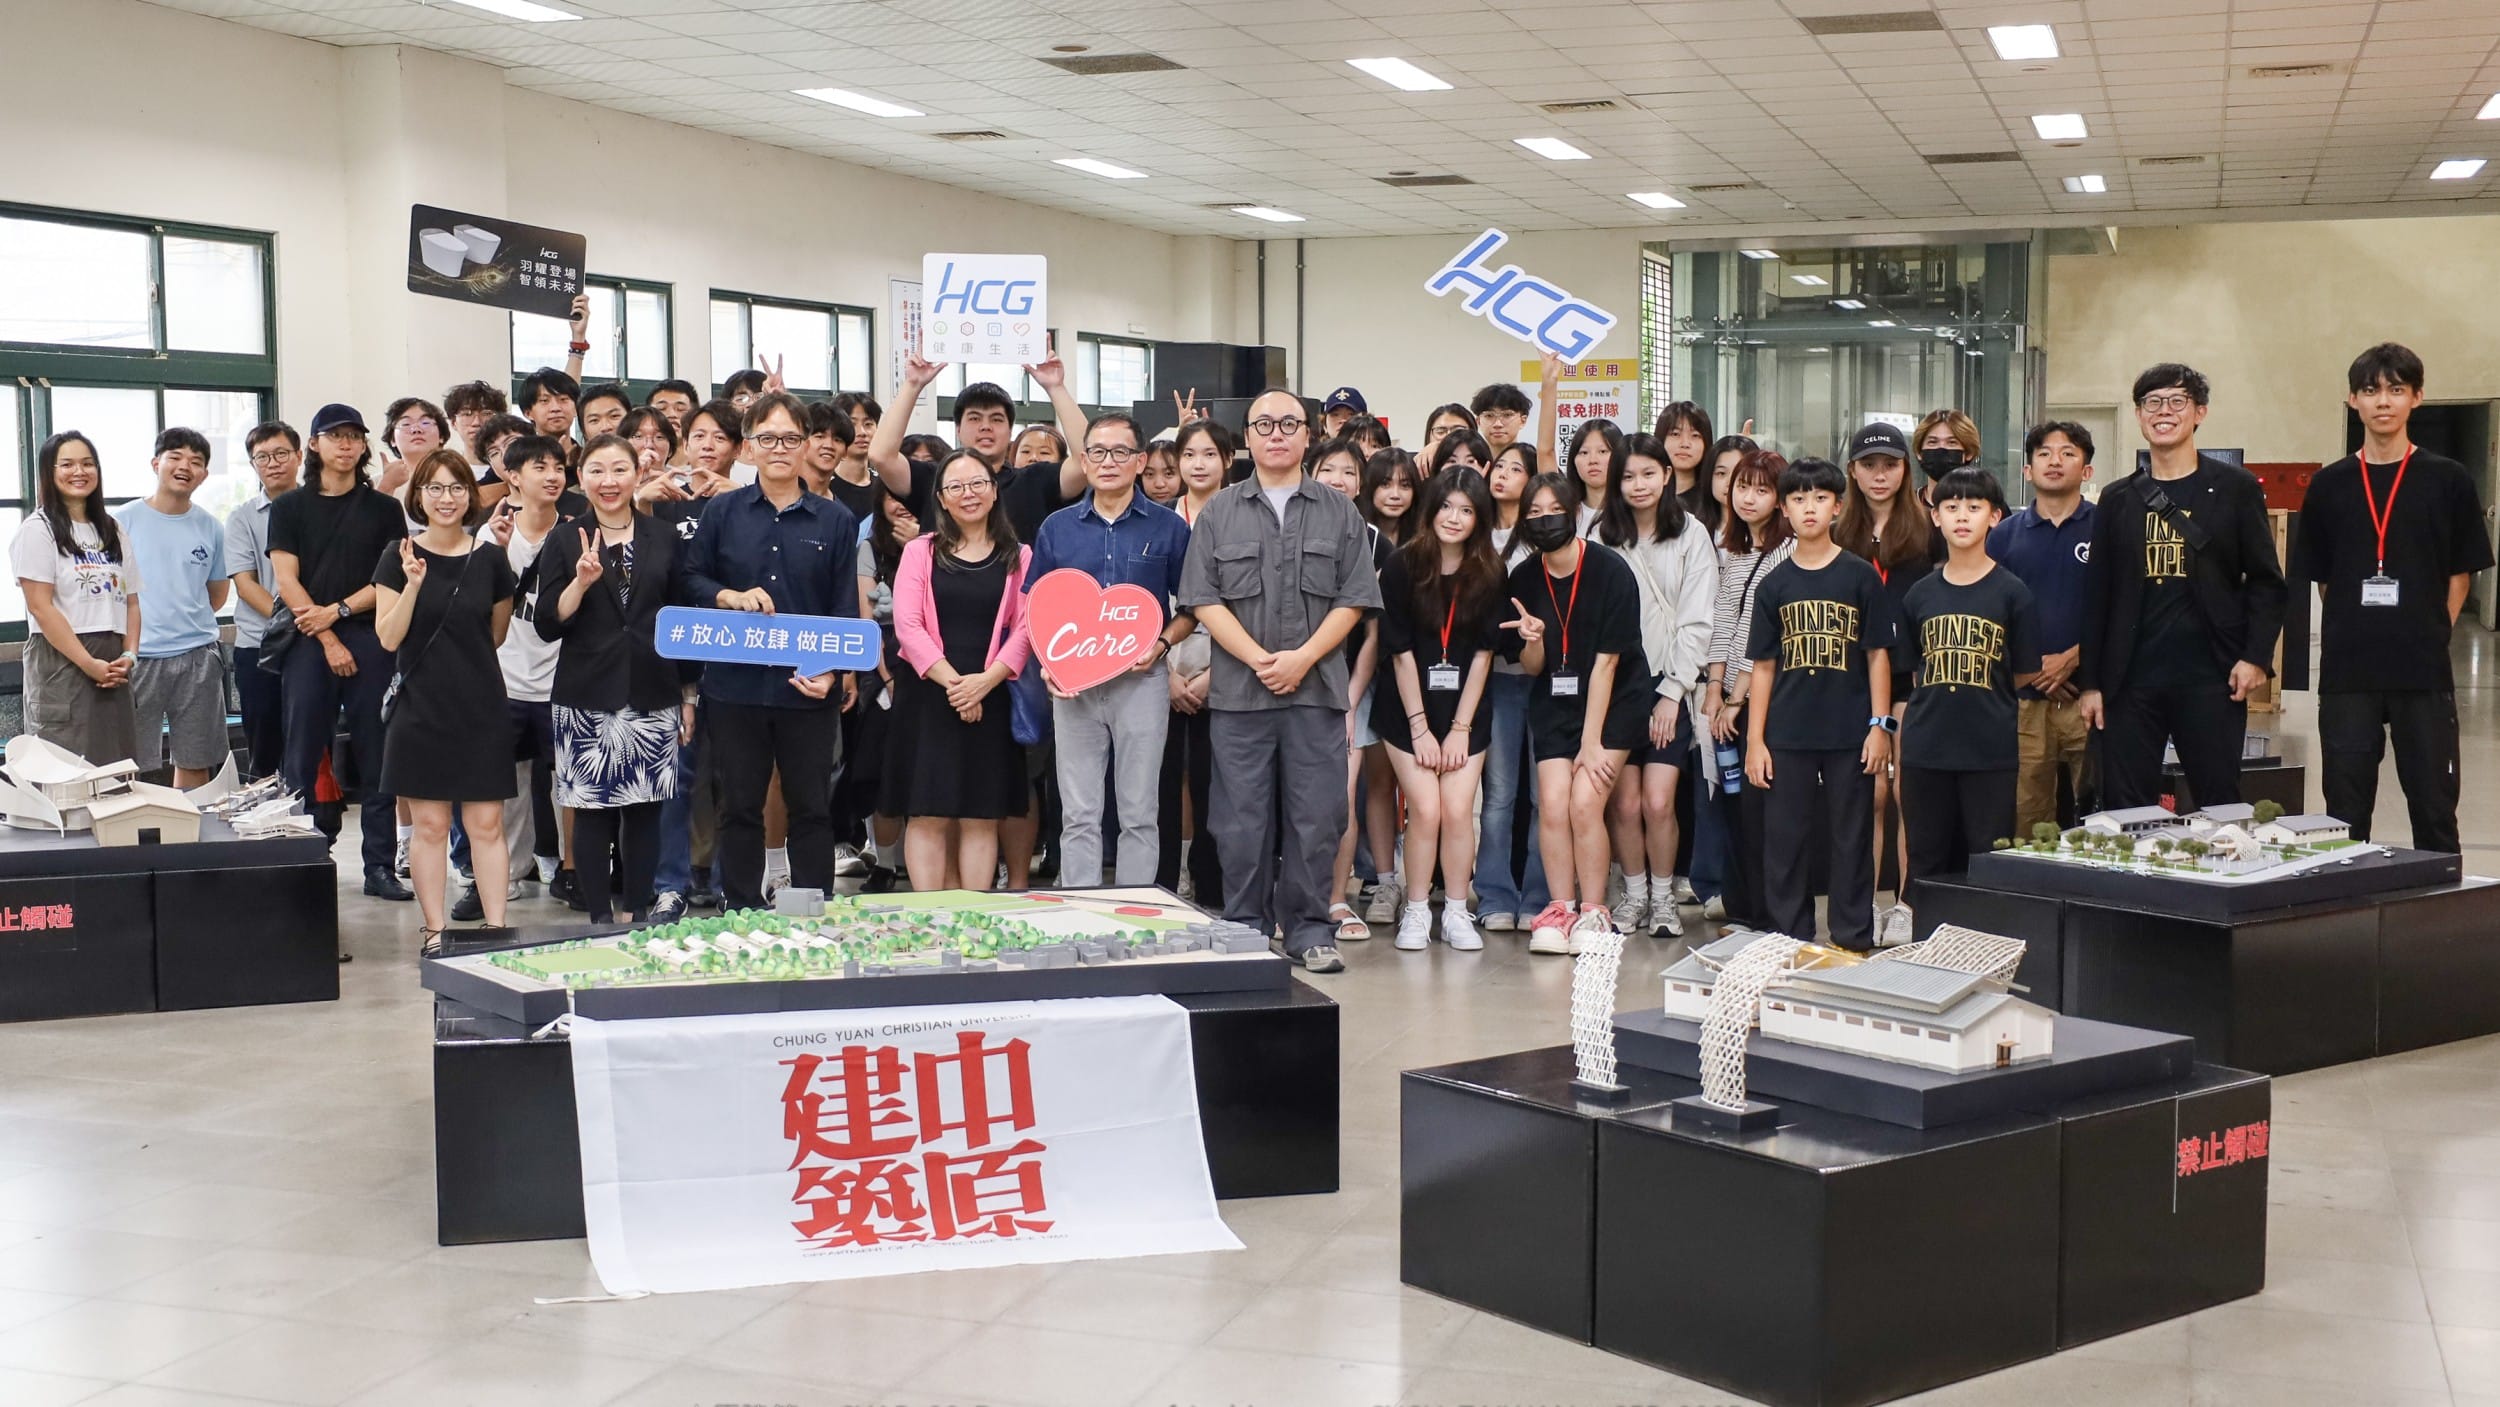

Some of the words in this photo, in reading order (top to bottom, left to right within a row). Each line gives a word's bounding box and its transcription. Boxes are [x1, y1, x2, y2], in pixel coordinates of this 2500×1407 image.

[540, 247, 558, 259] HCG
[520, 259, 577, 280] 羽耀登場
[520, 273, 576, 294] 智領未來
[933, 262, 1037, 315] HCG
[1432, 233, 1610, 359] HCG
[933, 342, 1031, 356] 健康生活
[1563, 364, 1619, 377] 迎使用
[1557, 402, 1620, 418] 餐免排隊
[1863, 435, 1892, 444] CELINE
[1099, 600, 1140, 622] HCG
[1778, 599, 1859, 642] HINESE
[690, 623, 737, 648] 放心
[743, 626, 790, 651] 放肆
[796, 629, 865, 656] 做自己
[1046, 622, 1139, 662] Care
[1782, 633, 1849, 672] TAIPEI
[1921, 648, 1993, 691] TAIPEI
[0, 904, 74, 932] 止觸碰
[773, 1032, 828, 1048] CHUNG
[835, 1027, 875, 1042] YUAN
[882, 1020, 953, 1037] CHRISTIAN
[2177, 1120, 2269, 1177] 禁止觸碰
